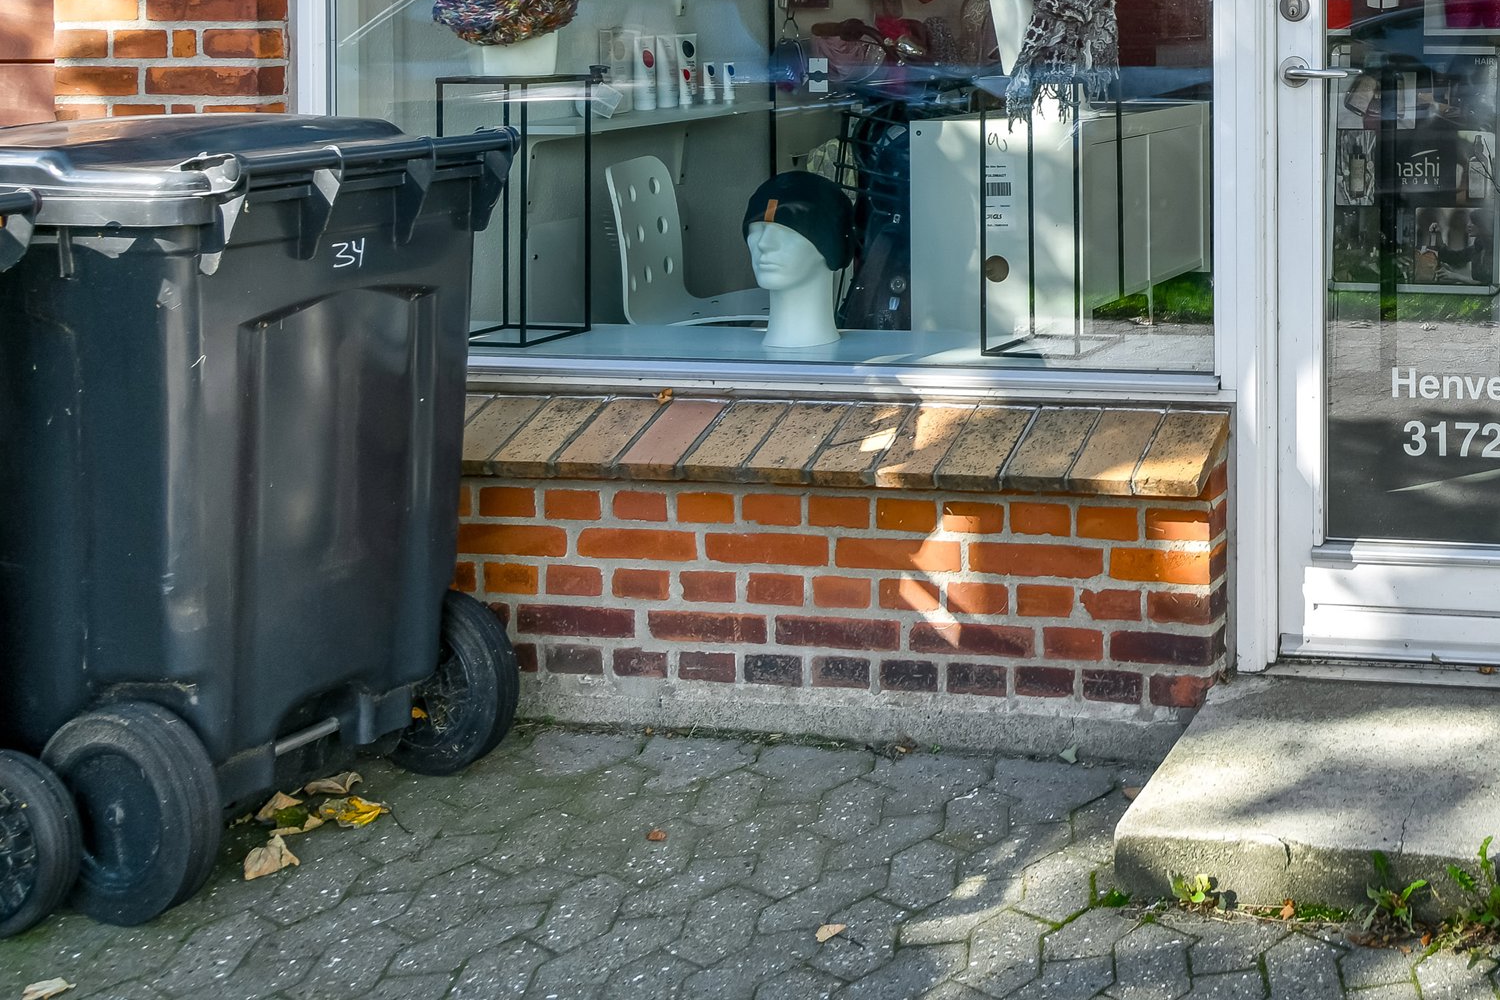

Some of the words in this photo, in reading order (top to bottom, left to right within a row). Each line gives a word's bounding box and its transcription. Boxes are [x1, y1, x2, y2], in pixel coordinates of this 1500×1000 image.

[1474, 57, 1494, 65] HAIR
[1401, 177, 1440, 185] RGAN
[331, 237, 366, 268] 34
